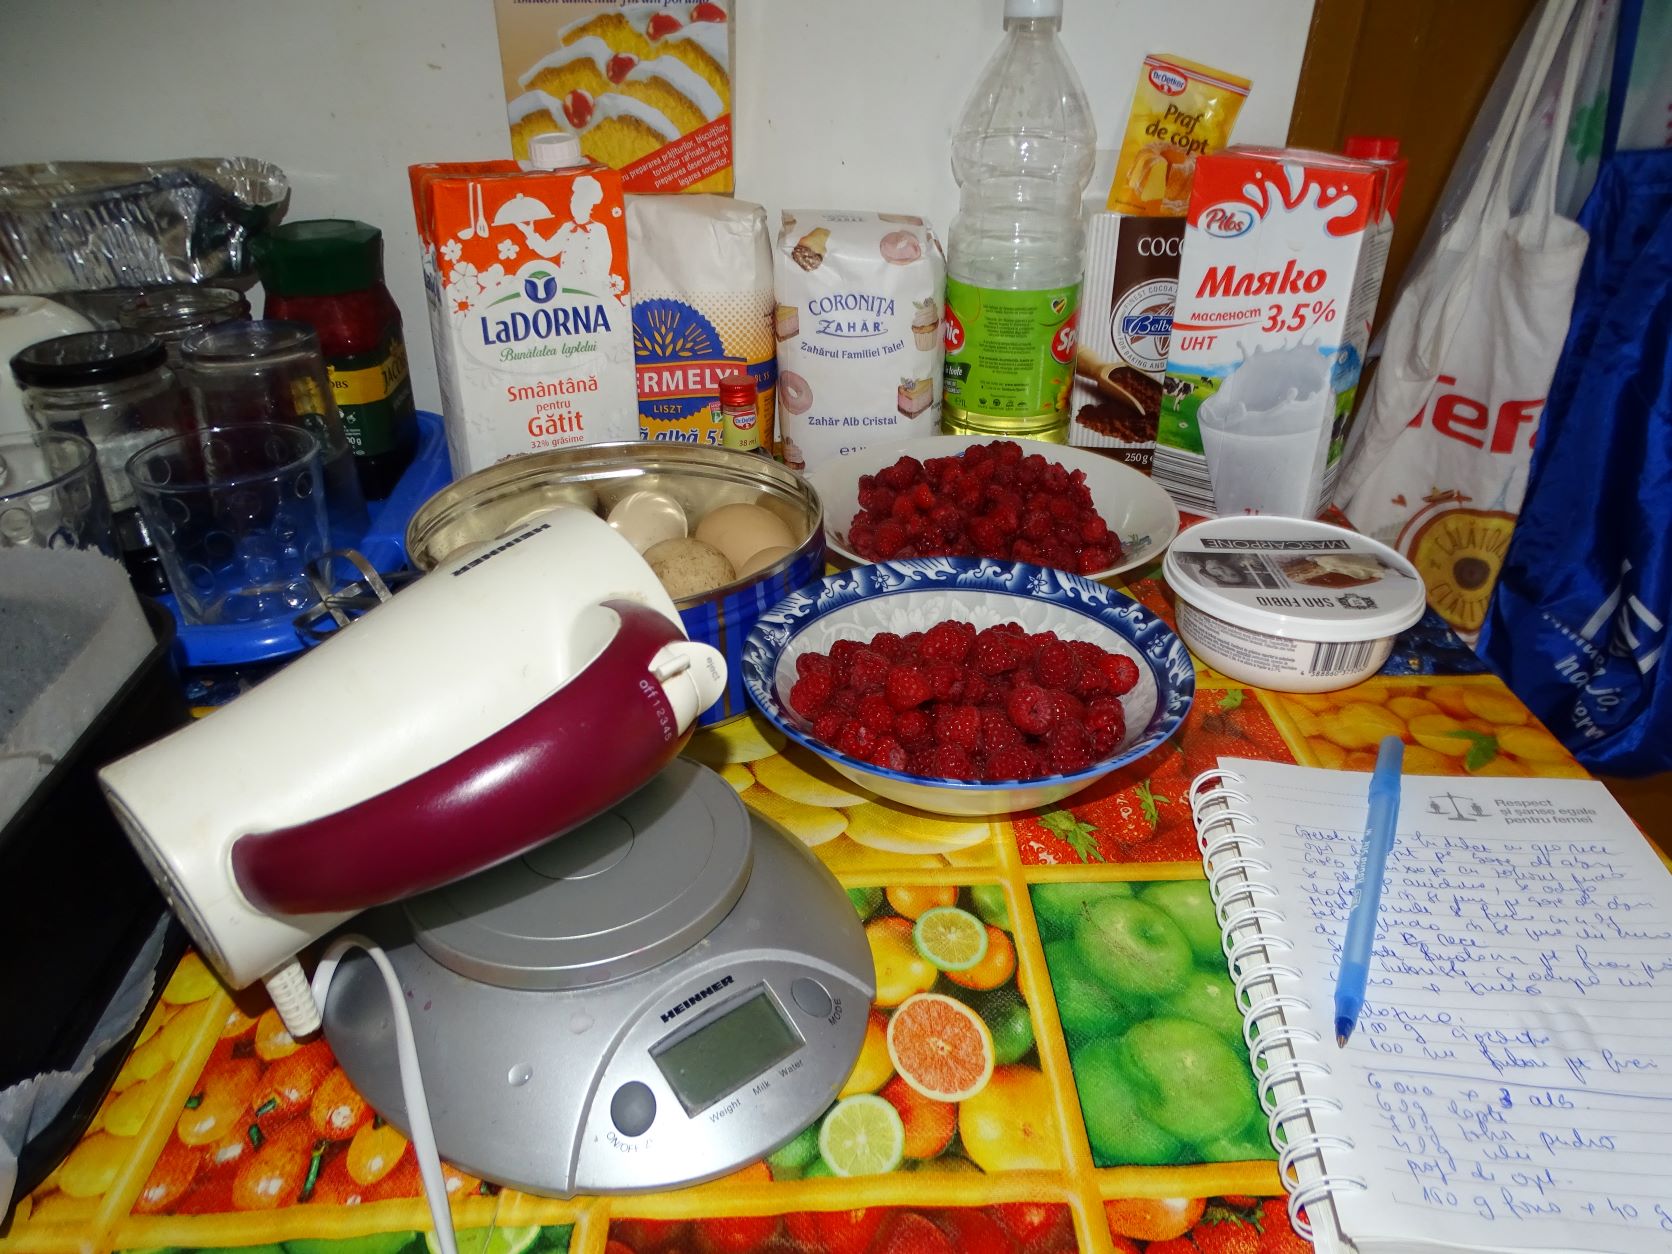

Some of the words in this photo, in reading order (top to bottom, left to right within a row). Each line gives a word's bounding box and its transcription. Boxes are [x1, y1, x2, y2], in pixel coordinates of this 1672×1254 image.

[1164, 103, 1204, 133] Praf
[707, 135, 729, 149] Pentru
[1145, 120, 1169, 140] de
[1170, 131, 1210, 156] copt
[629, 158, 661, 178] prepararea
[1204, 208, 1245, 233] Pilos
[1196, 259, 1327, 299] Мляко
[481, 304, 612, 345] LaDORNA
[1190, 308, 1261, 321] масленост
[1262, 299, 1336, 333] 3,5%
[801, 341, 839, 359] Zahărul
[842, 348, 880, 359] Familiei
[883, 340, 905, 354] Tale!
[1057, 327, 1077, 355] Sp
[1180, 336, 1217, 351] UHT
[1123, 350, 1147, 368] BAKING
[507, 375, 598, 402] Smântână
[536, 399, 571, 415] pentru
[654, 404, 682, 414] LISZT
[527, 411, 584, 437] Gătit
[808, 416, 839, 426] Zahăr
[843, 416, 859, 426] Alb
[863, 415, 897, 426] Cristal
[530, 438, 550, 449] 32%
[551, 433, 584, 448] grăsime
[1208, 539, 1347, 549] MASCARPONE
[1258, 596, 1300, 607] FABIO
[1302, 597, 1334, 607] SAN
[639, 679, 660, 699] off
[1494, 799, 1553, 808] Respect
[1559, 808, 1597, 816] egale
[1505, 816, 1551, 825] pentru
[1552, 815, 1593, 823] femei
[660, 975, 734, 1023] HEINNER
[828, 997, 842, 1026] MODE
[709, 1099, 741, 1124] Weight
[752, 1080, 771, 1096] Milk
[778, 1059, 803, 1079] Water
